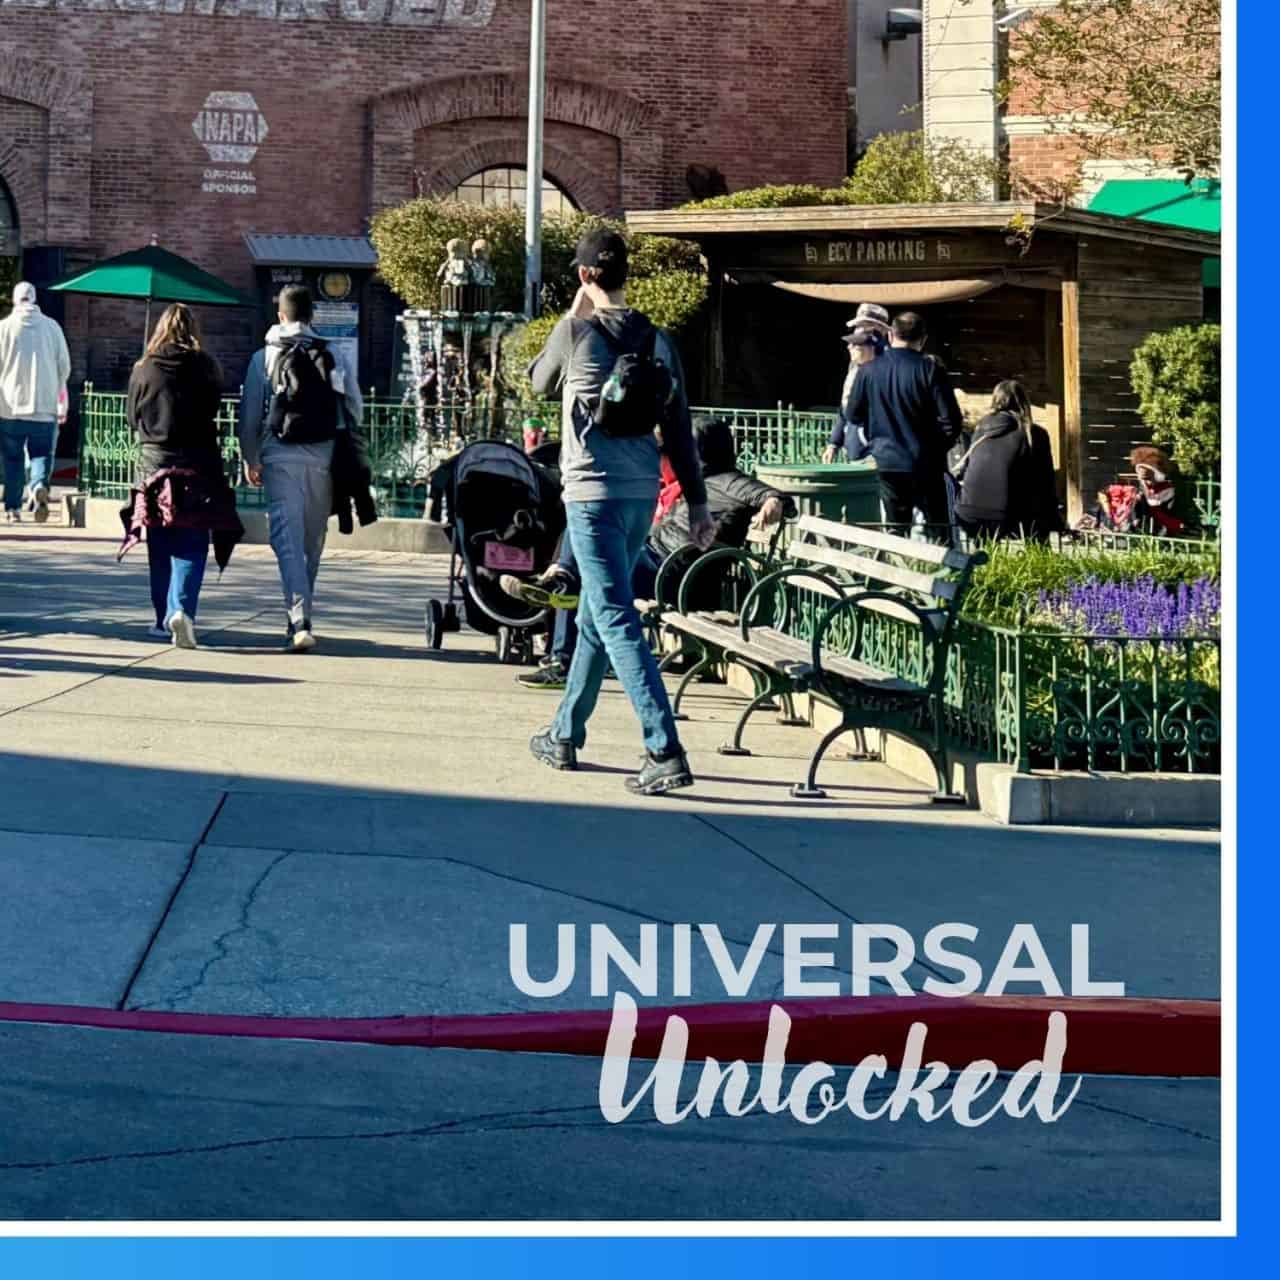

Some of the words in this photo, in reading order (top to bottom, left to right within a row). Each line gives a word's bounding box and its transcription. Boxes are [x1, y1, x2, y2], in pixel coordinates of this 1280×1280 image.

[205, 111, 257, 143] NAPA
[203, 169, 257, 180] OFFICIAL
[201, 182, 257, 195] SPONSOR
[856, 240, 926, 262] PARKING
